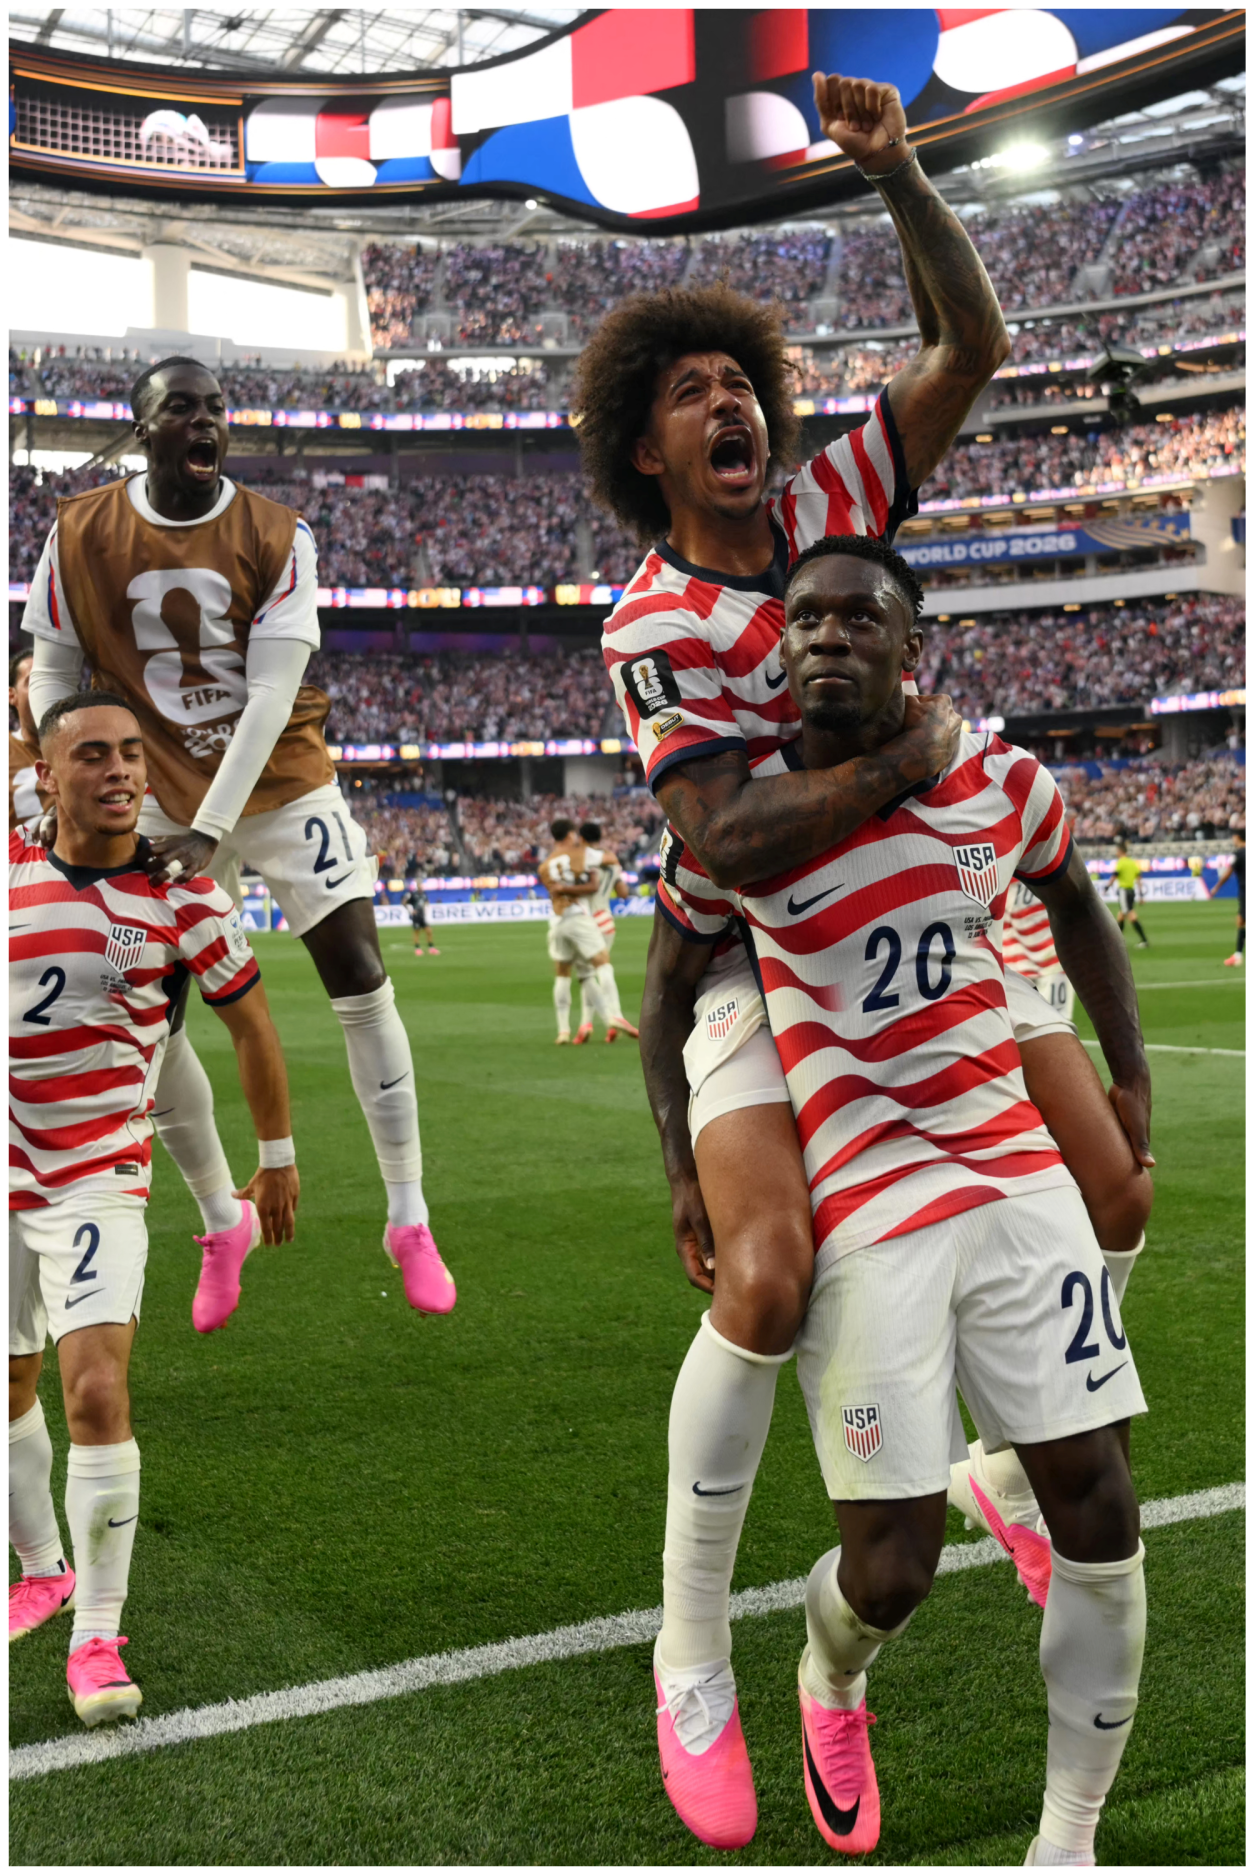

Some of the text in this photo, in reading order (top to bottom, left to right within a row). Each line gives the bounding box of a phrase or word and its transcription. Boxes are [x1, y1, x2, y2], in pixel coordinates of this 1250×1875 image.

[900, 533, 1077, 565] WORLD CUP 2026
[181, 688, 232, 711] FIFA
[644, 688, 657, 696] FIFA
[304, 811, 354, 874] 21
[956, 845, 994, 871] USA
[1152, 880, 1196, 896] HERE
[431, 903, 524, 920] BREWED
[111, 926, 145, 947] USA
[862, 921, 956, 1013] 20
[22, 966, 66, 1025] 2
[1050, 981, 1067, 1006] 10
[707, 1000, 736, 1023] USA
[69, 1222, 100, 1285] 2
[1061, 1264, 1126, 1364] 20
[843, 1406, 876, 1430] USA
